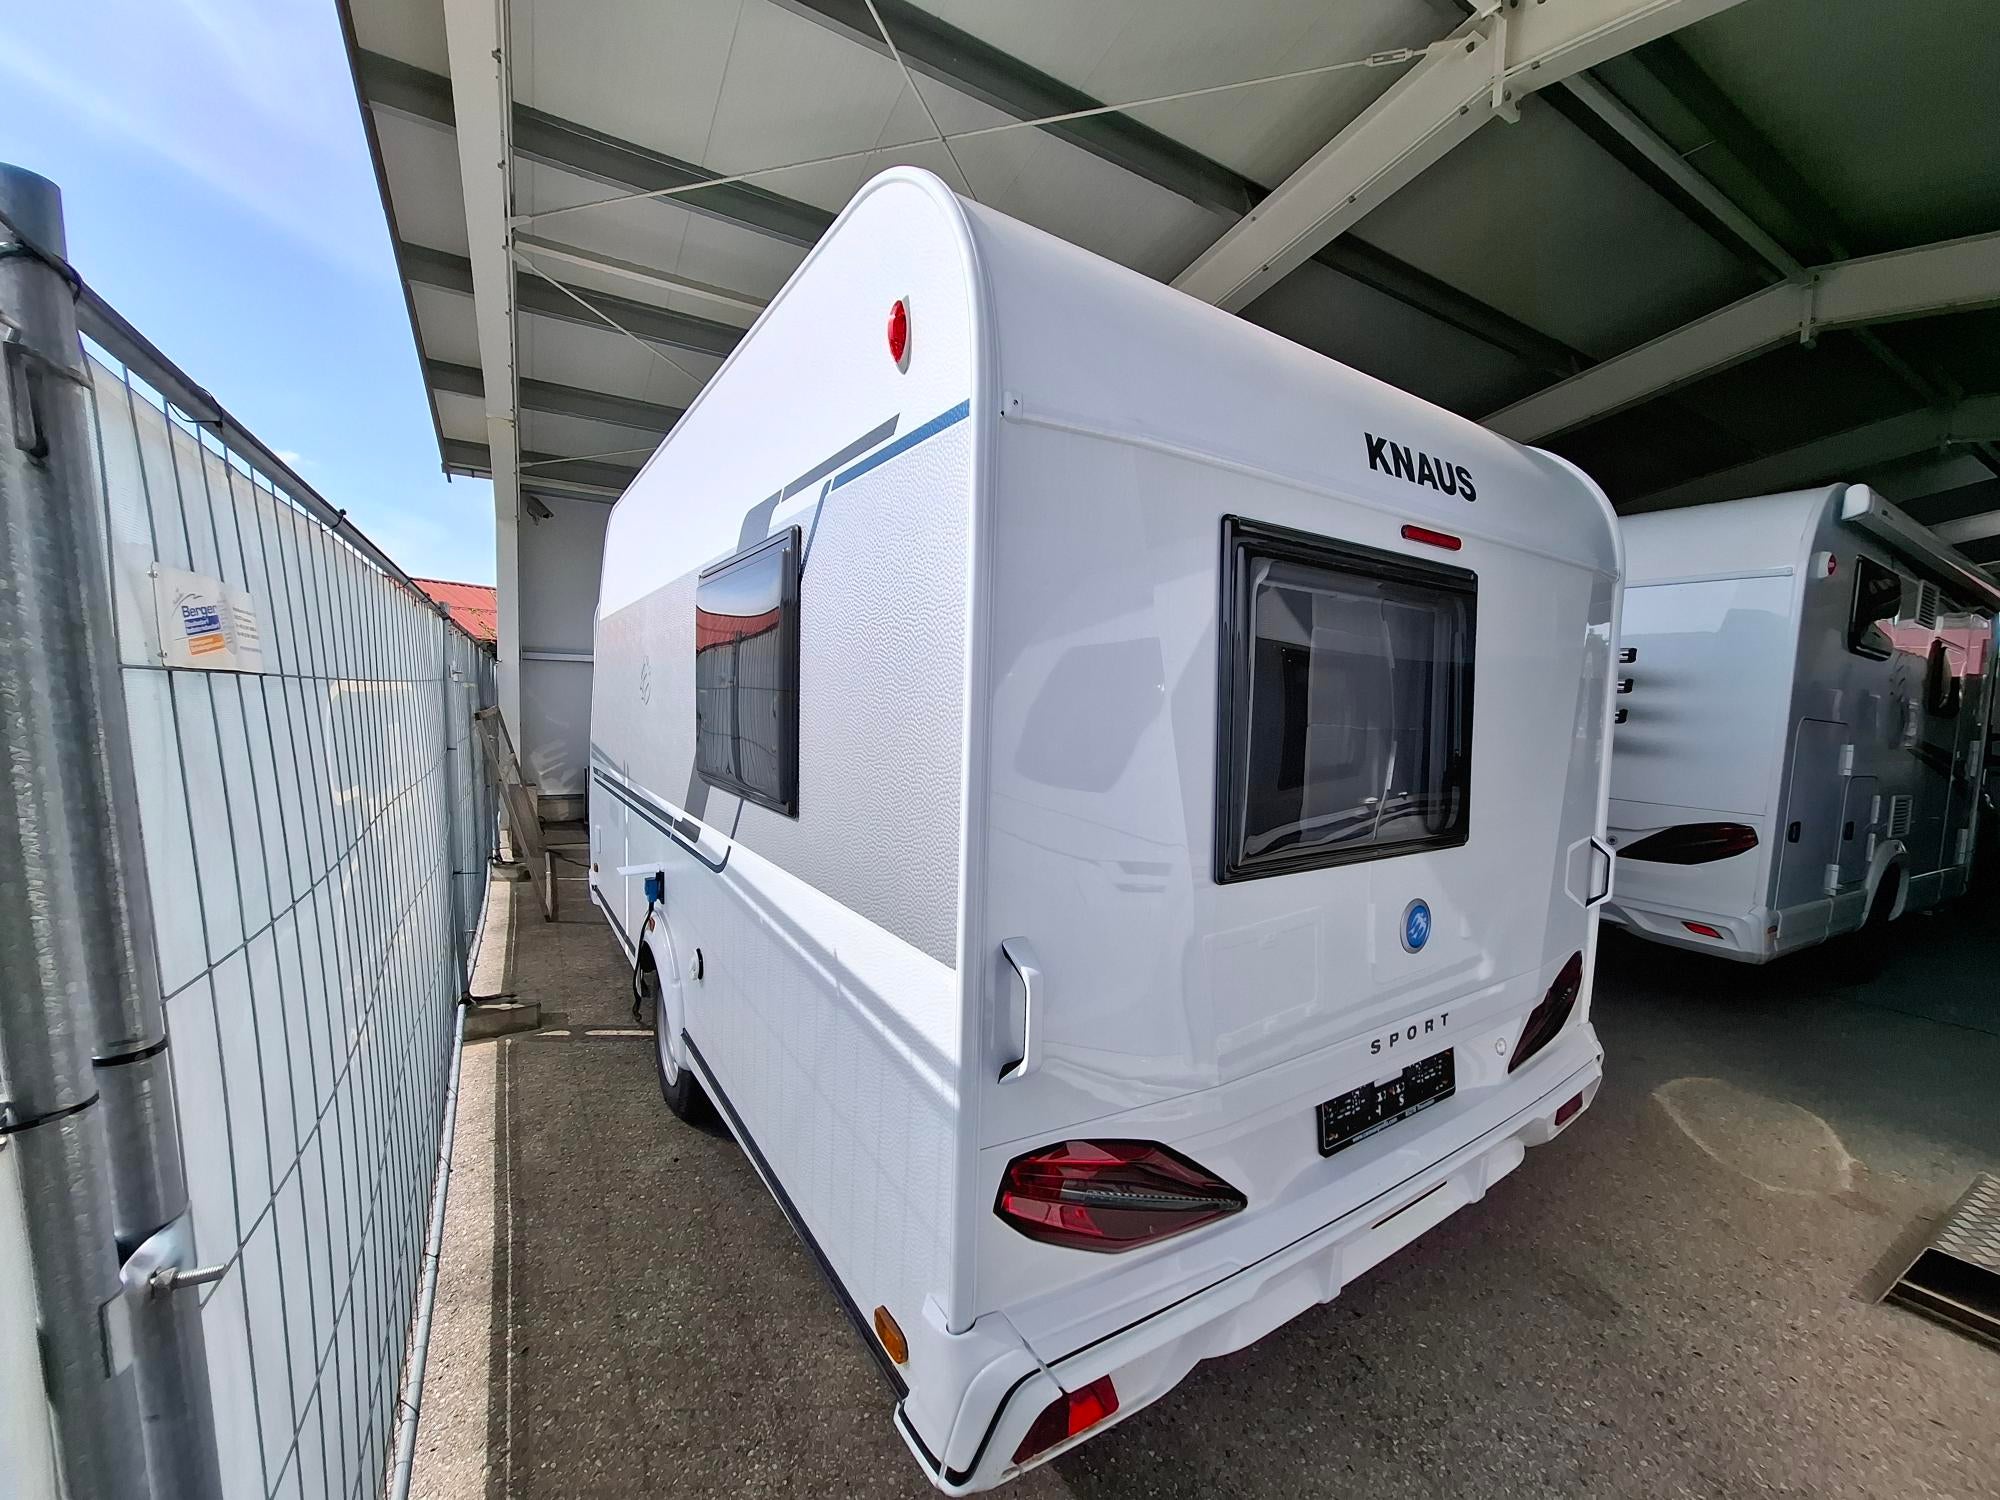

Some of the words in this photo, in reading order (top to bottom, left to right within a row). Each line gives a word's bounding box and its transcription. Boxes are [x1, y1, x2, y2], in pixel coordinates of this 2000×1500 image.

[1364, 432, 1477, 502] KNAUS
[181, 605, 217, 619] Berger
[1370, 1013, 1449, 1055] SPORT
